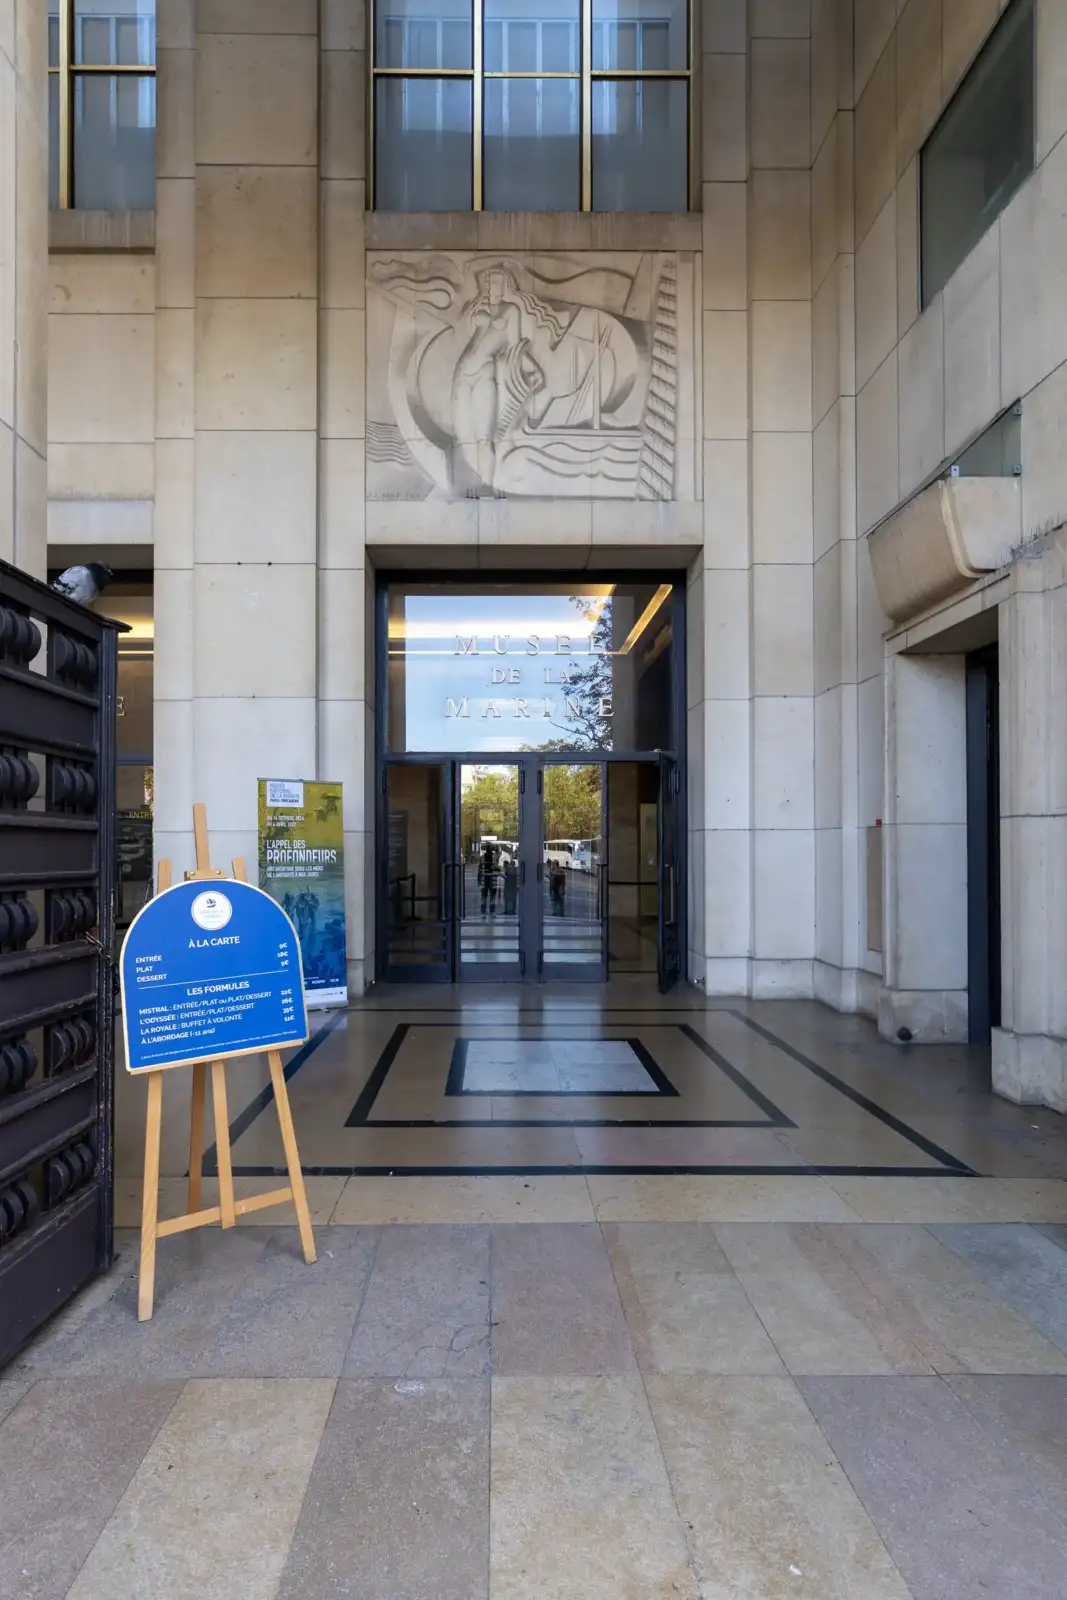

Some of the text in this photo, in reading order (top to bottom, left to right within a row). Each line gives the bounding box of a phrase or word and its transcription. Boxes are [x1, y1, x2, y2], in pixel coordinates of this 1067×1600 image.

[454, 634, 606, 656] MUSEE
[492, 668, 573, 684] DE LA
[445, 697, 615, 718] MARINE
[267, 840, 306, 849] L'APPEL DES
[266, 849, 337, 864] PROFONDEURS
[188, 936, 240, 949] À LA CARTE
[135, 954, 162, 964] ENTRÉE
[136, 965, 153, 973] PLAT
[136, 974, 168, 982] DESSERT
[186, 981, 250, 996] LES FORMULES
[139, 1006, 169, 1015] MISTRAL
[173, 1000, 218, 1010] ENTRÉE/PLAT
[227, 991, 272, 1003] PLAT/DESSERT
[140, 1014, 176, 1025] L'ODYSSÉE
[180, 1002, 255, 1019] ENTRÉE/PLAT/DESSERT
[150, 1024, 177, 1034] ROYALE
[181, 1019, 206, 1029] BUFFET
[212, 1013, 242, 1024] VOLONTÉ
[141, 1036, 146, 1045] À
[147, 1032, 189, 1044] L'ABORDAGE
